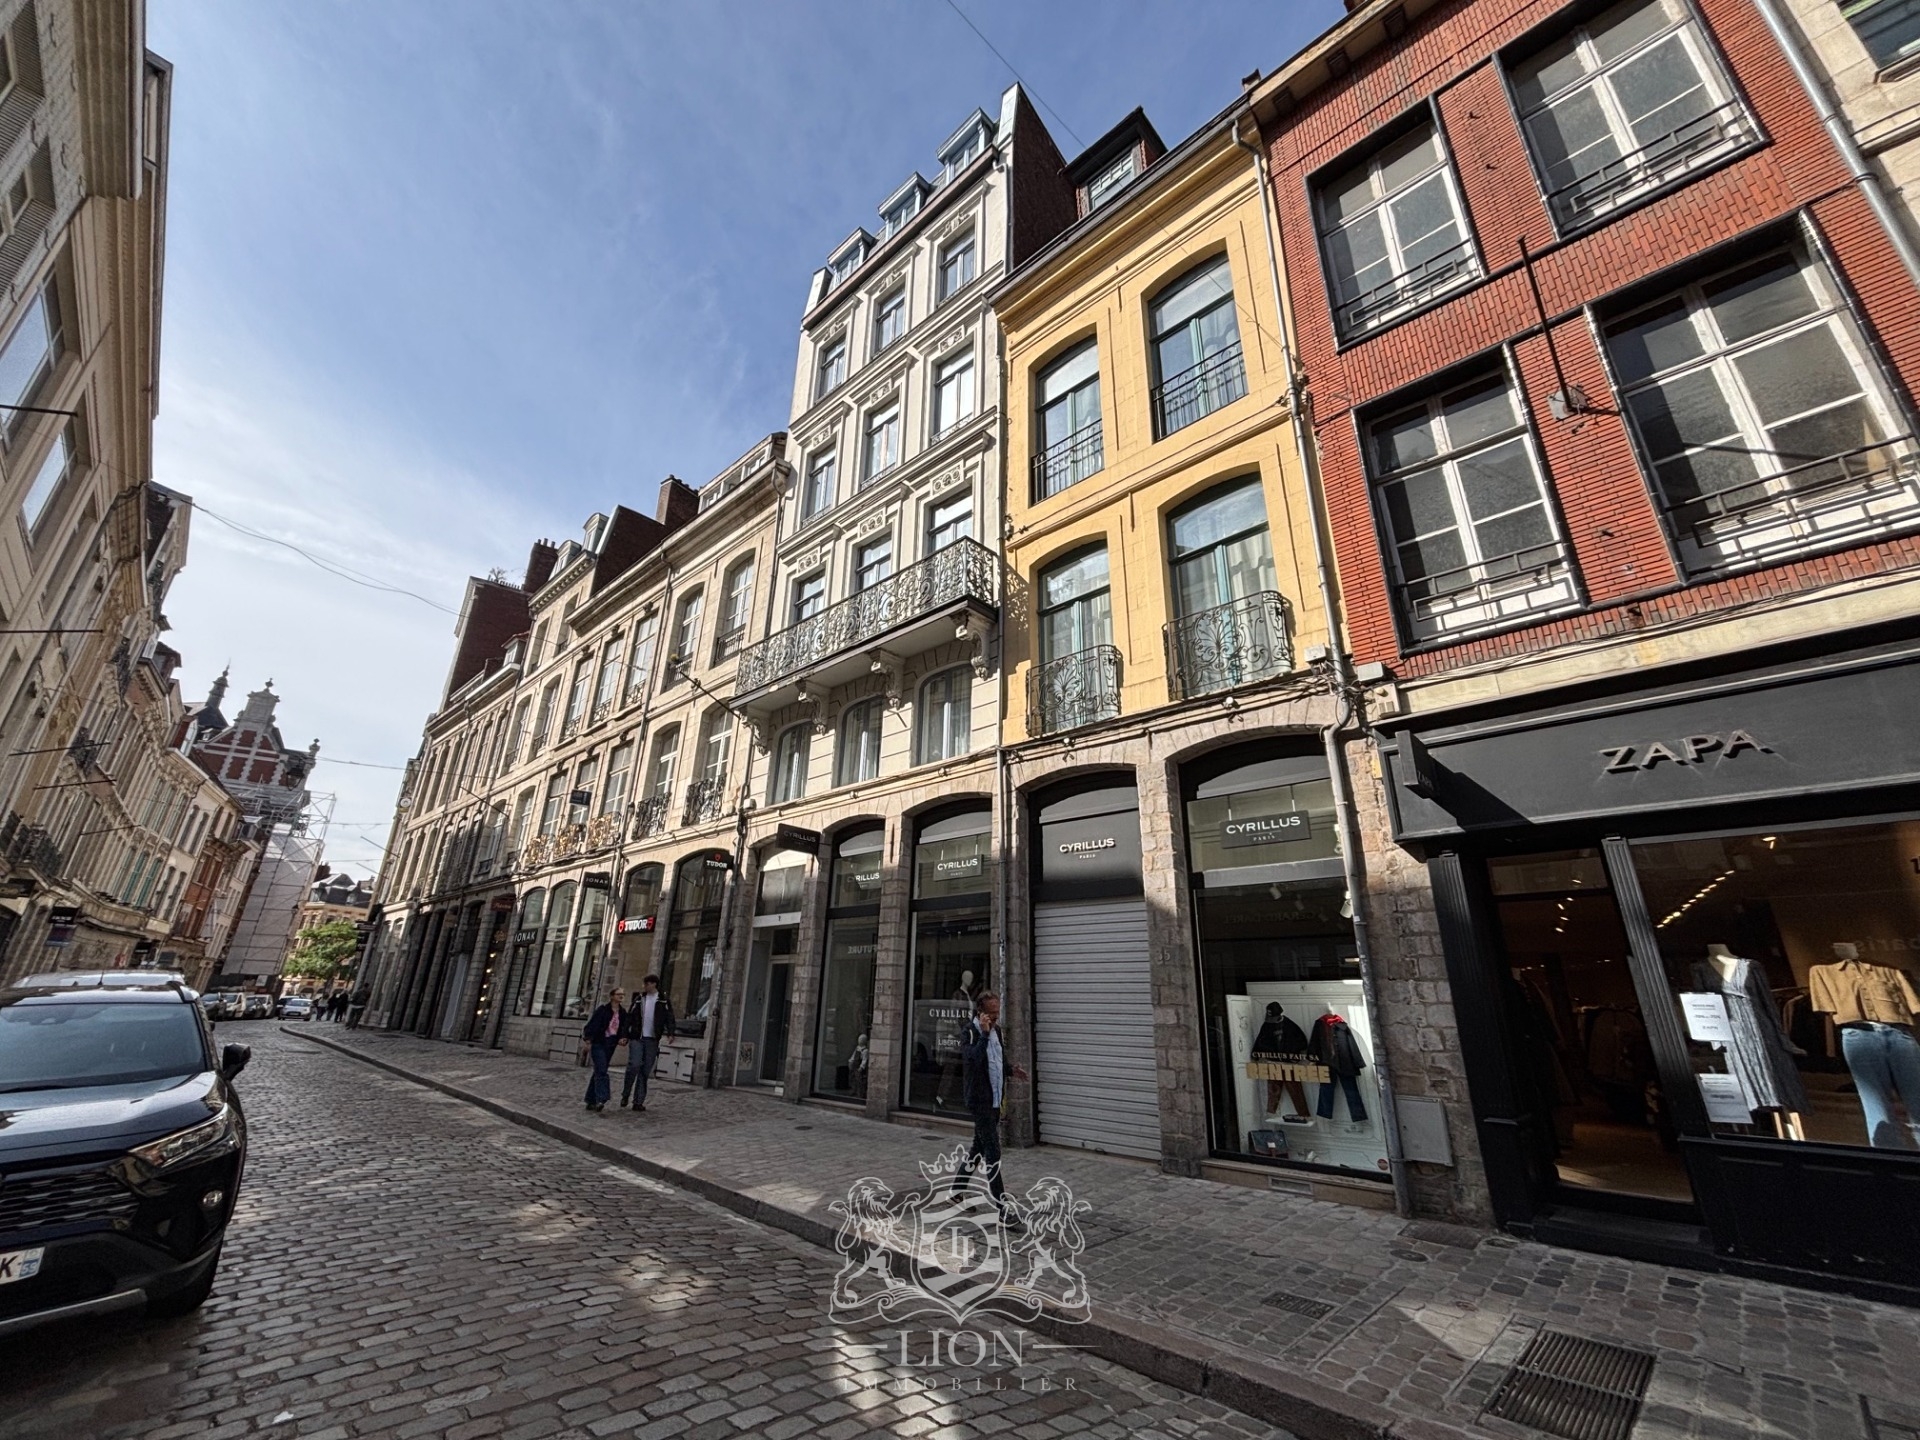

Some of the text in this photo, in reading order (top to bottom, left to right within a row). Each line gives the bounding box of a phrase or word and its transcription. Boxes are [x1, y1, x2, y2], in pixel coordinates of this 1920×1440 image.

[1599, 729, 1775, 774] ZAPA
[1226, 816, 1301, 834] CYRILLUS
[783, 830, 817, 843] CYRILLUS
[1253, 833, 1276, 841] PARIS
[1059, 838, 1116, 853] CYRILLUS
[706, 860, 728, 868] TUDOR
[937, 858, 979, 871] CYRILLUS
[624, 919, 648, 932] TUDOR
[929, 1008, 973, 1018] CYRILLUS
[1251, 1051, 1287, 1060] CYRILLUS
[1289, 1052, 1307, 1061] FAIT
